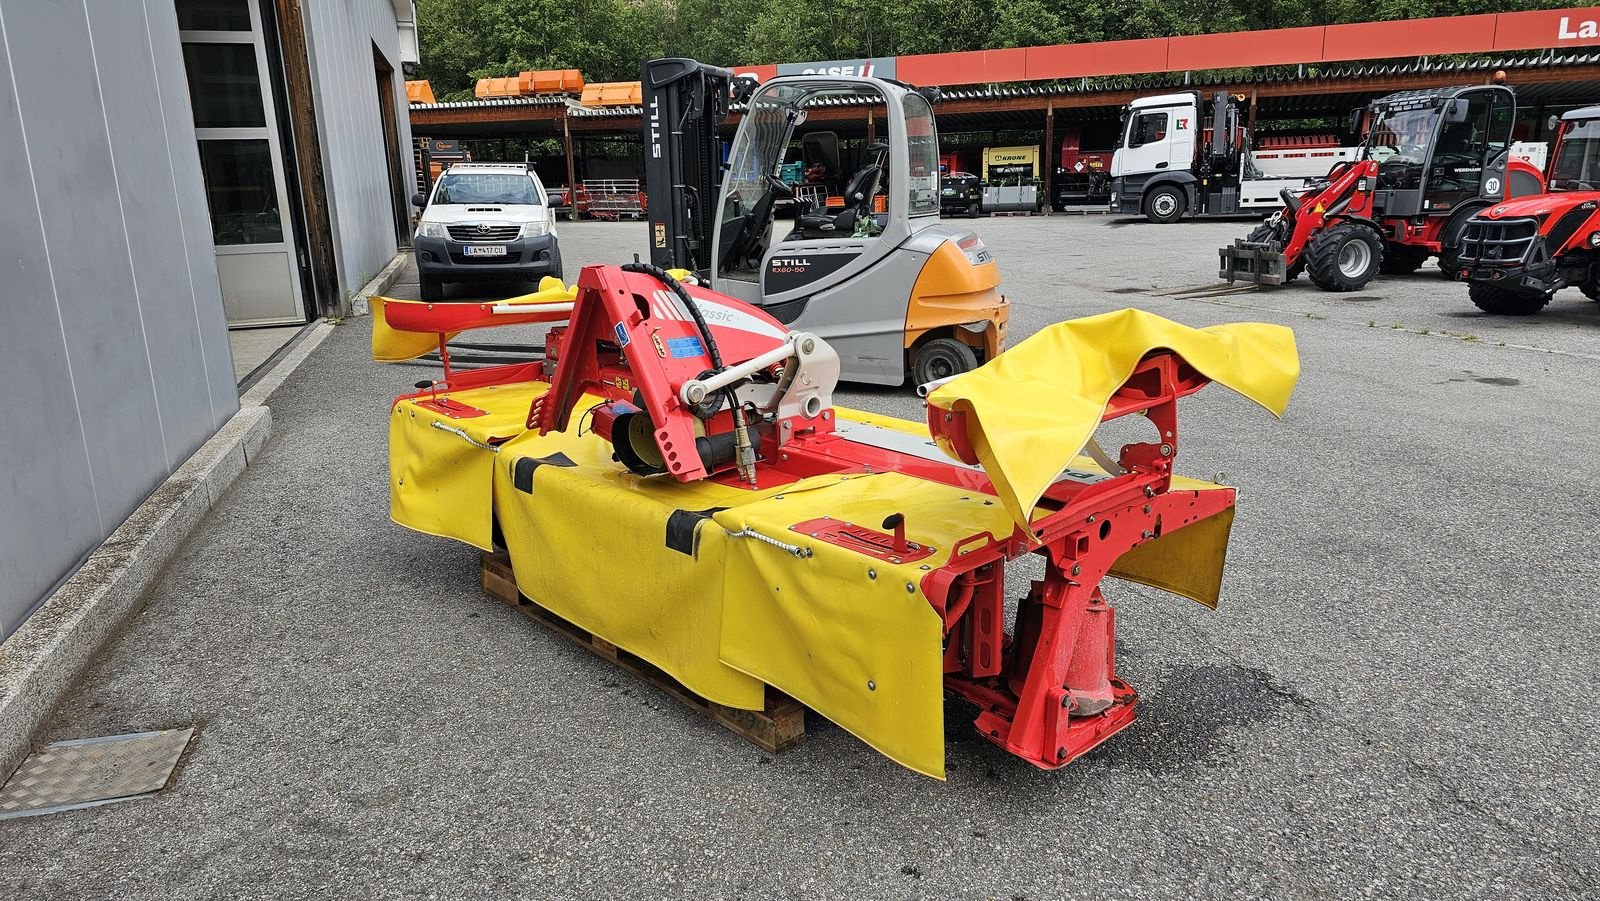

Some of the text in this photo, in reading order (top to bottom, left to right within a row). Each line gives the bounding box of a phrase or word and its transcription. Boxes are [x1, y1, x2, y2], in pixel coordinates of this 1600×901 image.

[1558, 16, 1600, 39] La
[650, 95, 661, 158] STILL
[1488, 181, 1498, 191] 30
[699, 303, 735, 322] lassic
